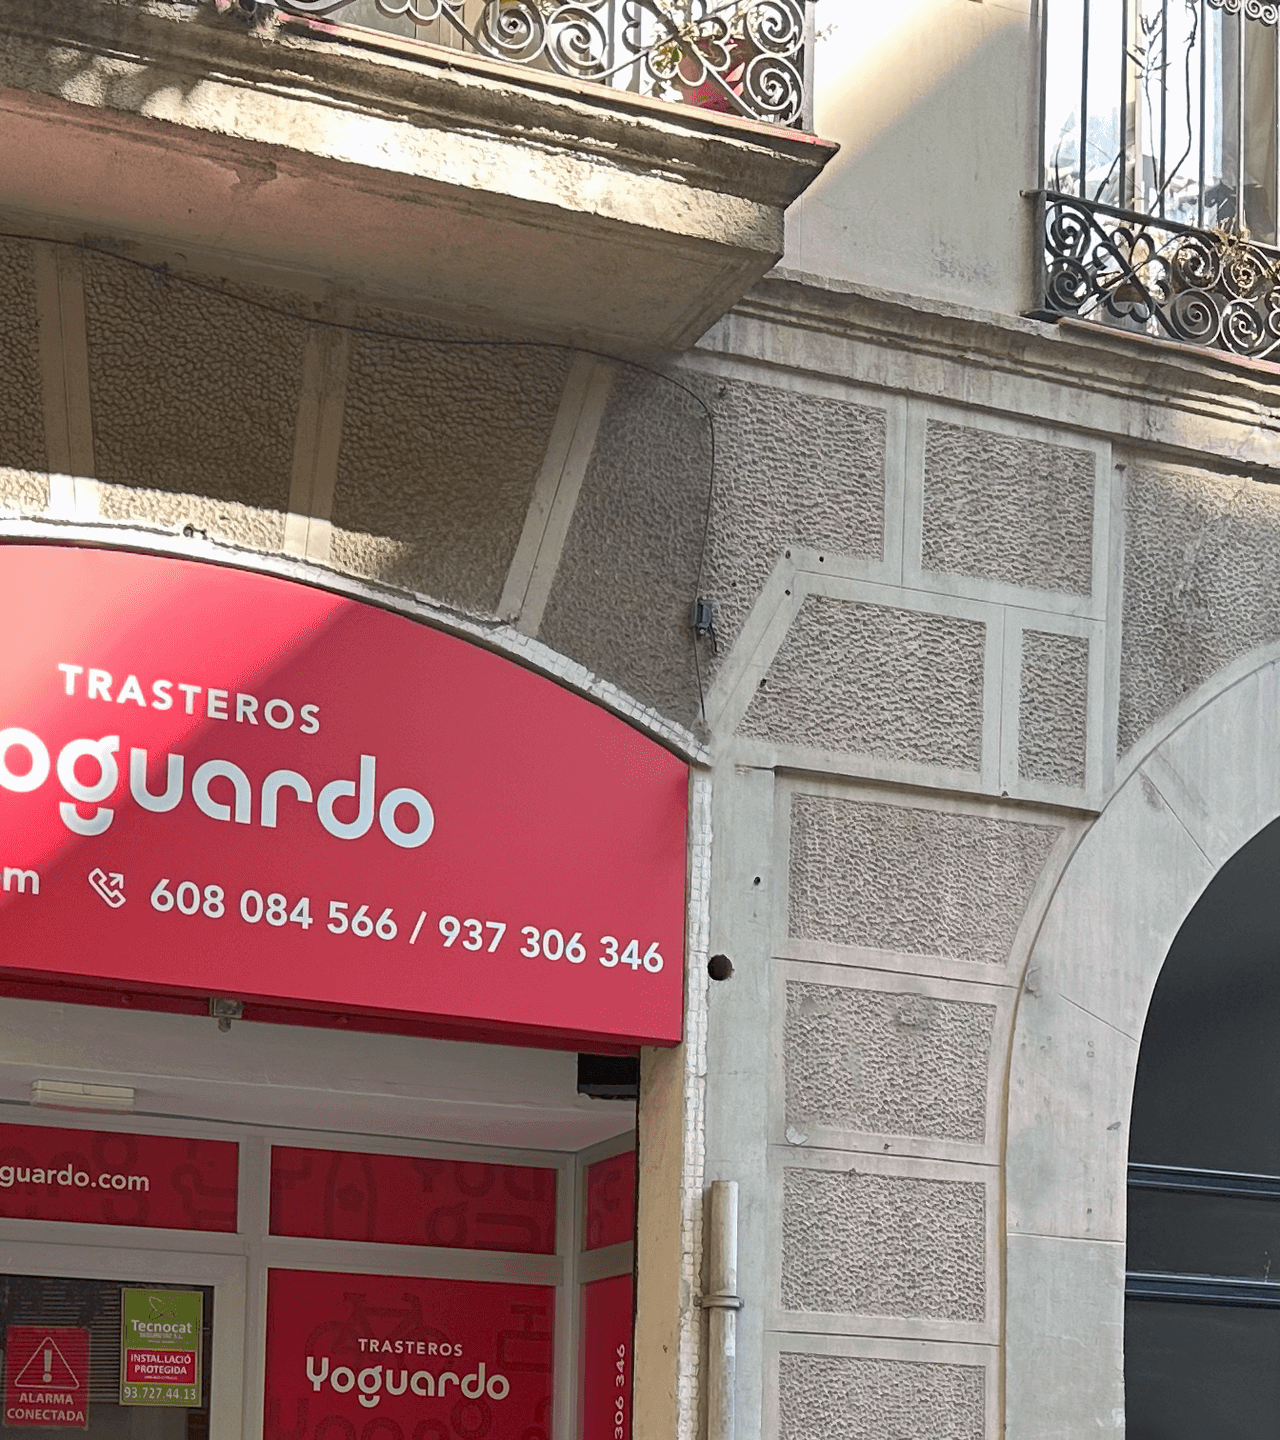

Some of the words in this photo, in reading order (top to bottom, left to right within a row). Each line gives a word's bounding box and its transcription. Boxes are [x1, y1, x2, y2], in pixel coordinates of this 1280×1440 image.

[57, 662, 321, 734] TRASTEROS
[151, 879, 224, 918] 608
[241, 890, 313, 929] 084
[327, 901, 397, 940] 566
[409, 911, 426, 944] /
[439, 916, 506, 952] 937
[520, 926, 586, 963] 306
[599, 936, 663, 972] 346
[130, 1319, 192, 1334] Tecnocat
[358, 1339, 462, 1356] TRASTEROS
[134, 1364, 187, 1375] PROTEGIDA
[615, 1344, 627, 1386] 346
[307, 1357, 509, 1407] Yoguardo
[18, 1392, 74, 1405] ALARMA
[124, 1386, 197, 1400] 93.727.44.13
[6, 1408, 85, 1422] CONECTADA
[614, 1396, 625, 1439] 306
